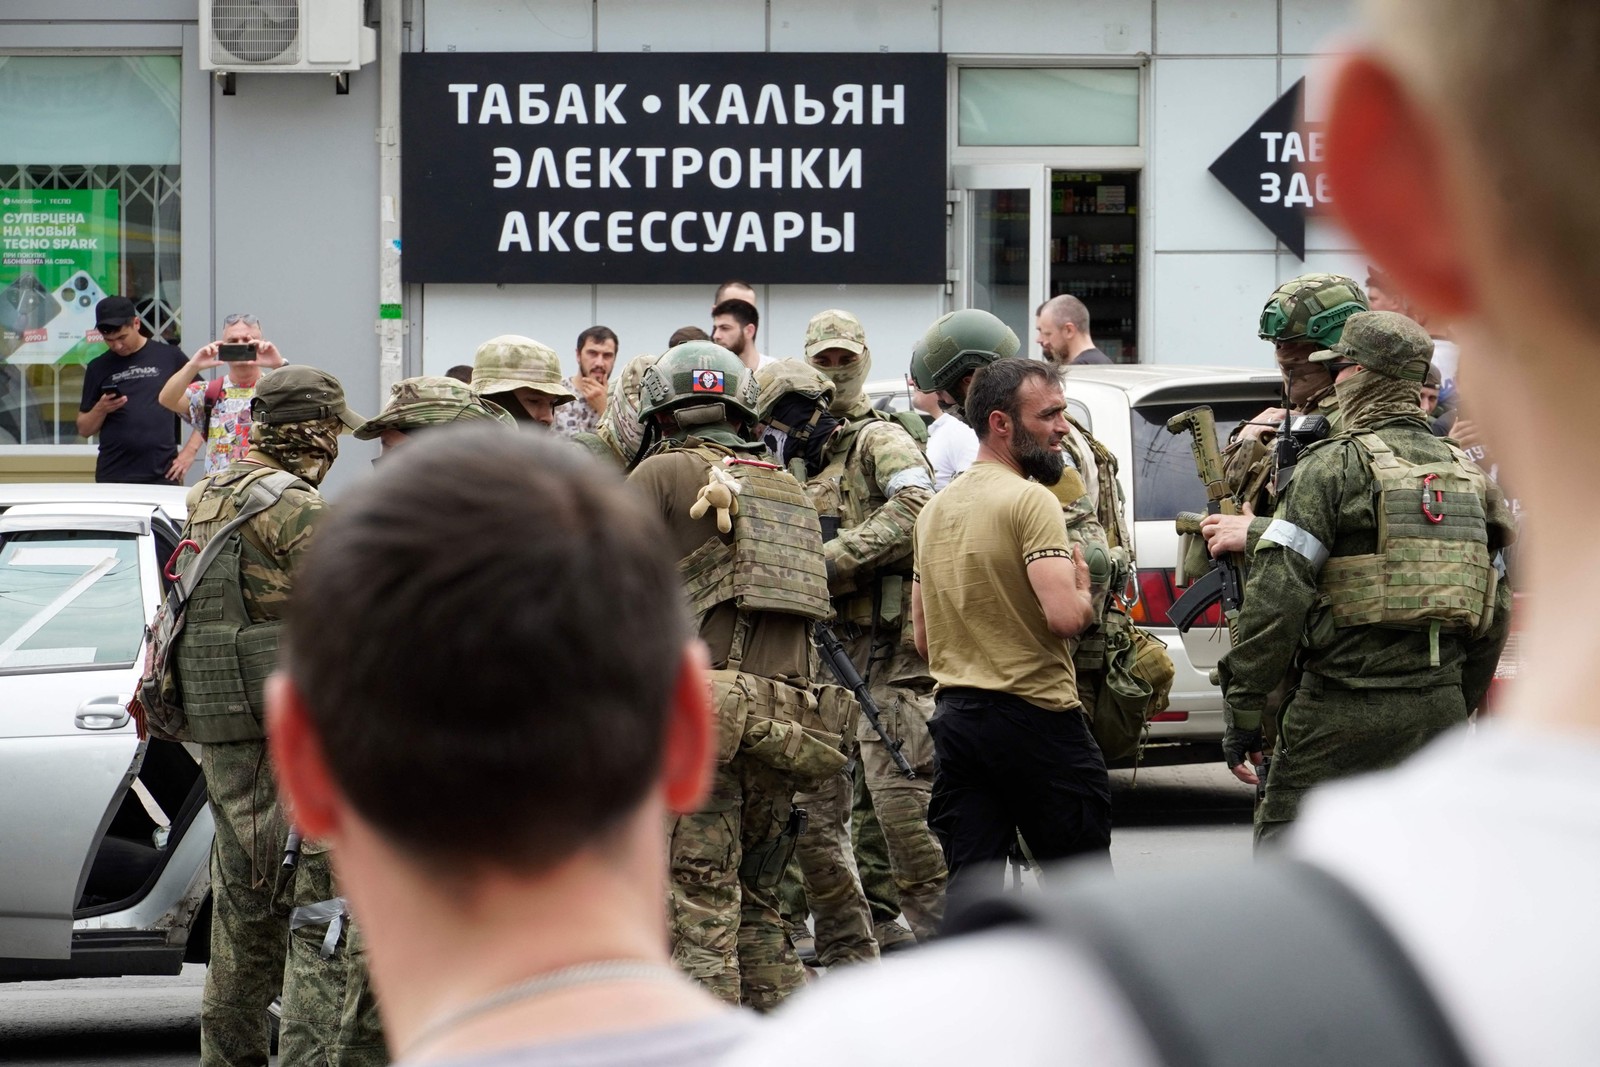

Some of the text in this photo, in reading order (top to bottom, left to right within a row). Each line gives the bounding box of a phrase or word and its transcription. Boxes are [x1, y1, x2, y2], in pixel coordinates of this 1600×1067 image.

[448, 83, 905, 125] ТАБАК КАЛЬЯН
[1260, 131, 1327, 163] ТАБ
[493, 146, 862, 189] ЭЛЕКТРОНКИ
[1260, 172, 1334, 208] ЗДЕ
[3, 212, 85, 225] СУПЕРЦЕНА
[3, 224, 77, 236] НА НОВЫЙ
[497, 210, 855, 253] АКСЕССУАРЫ
[3, 238, 98, 249] TECNO SPARK
